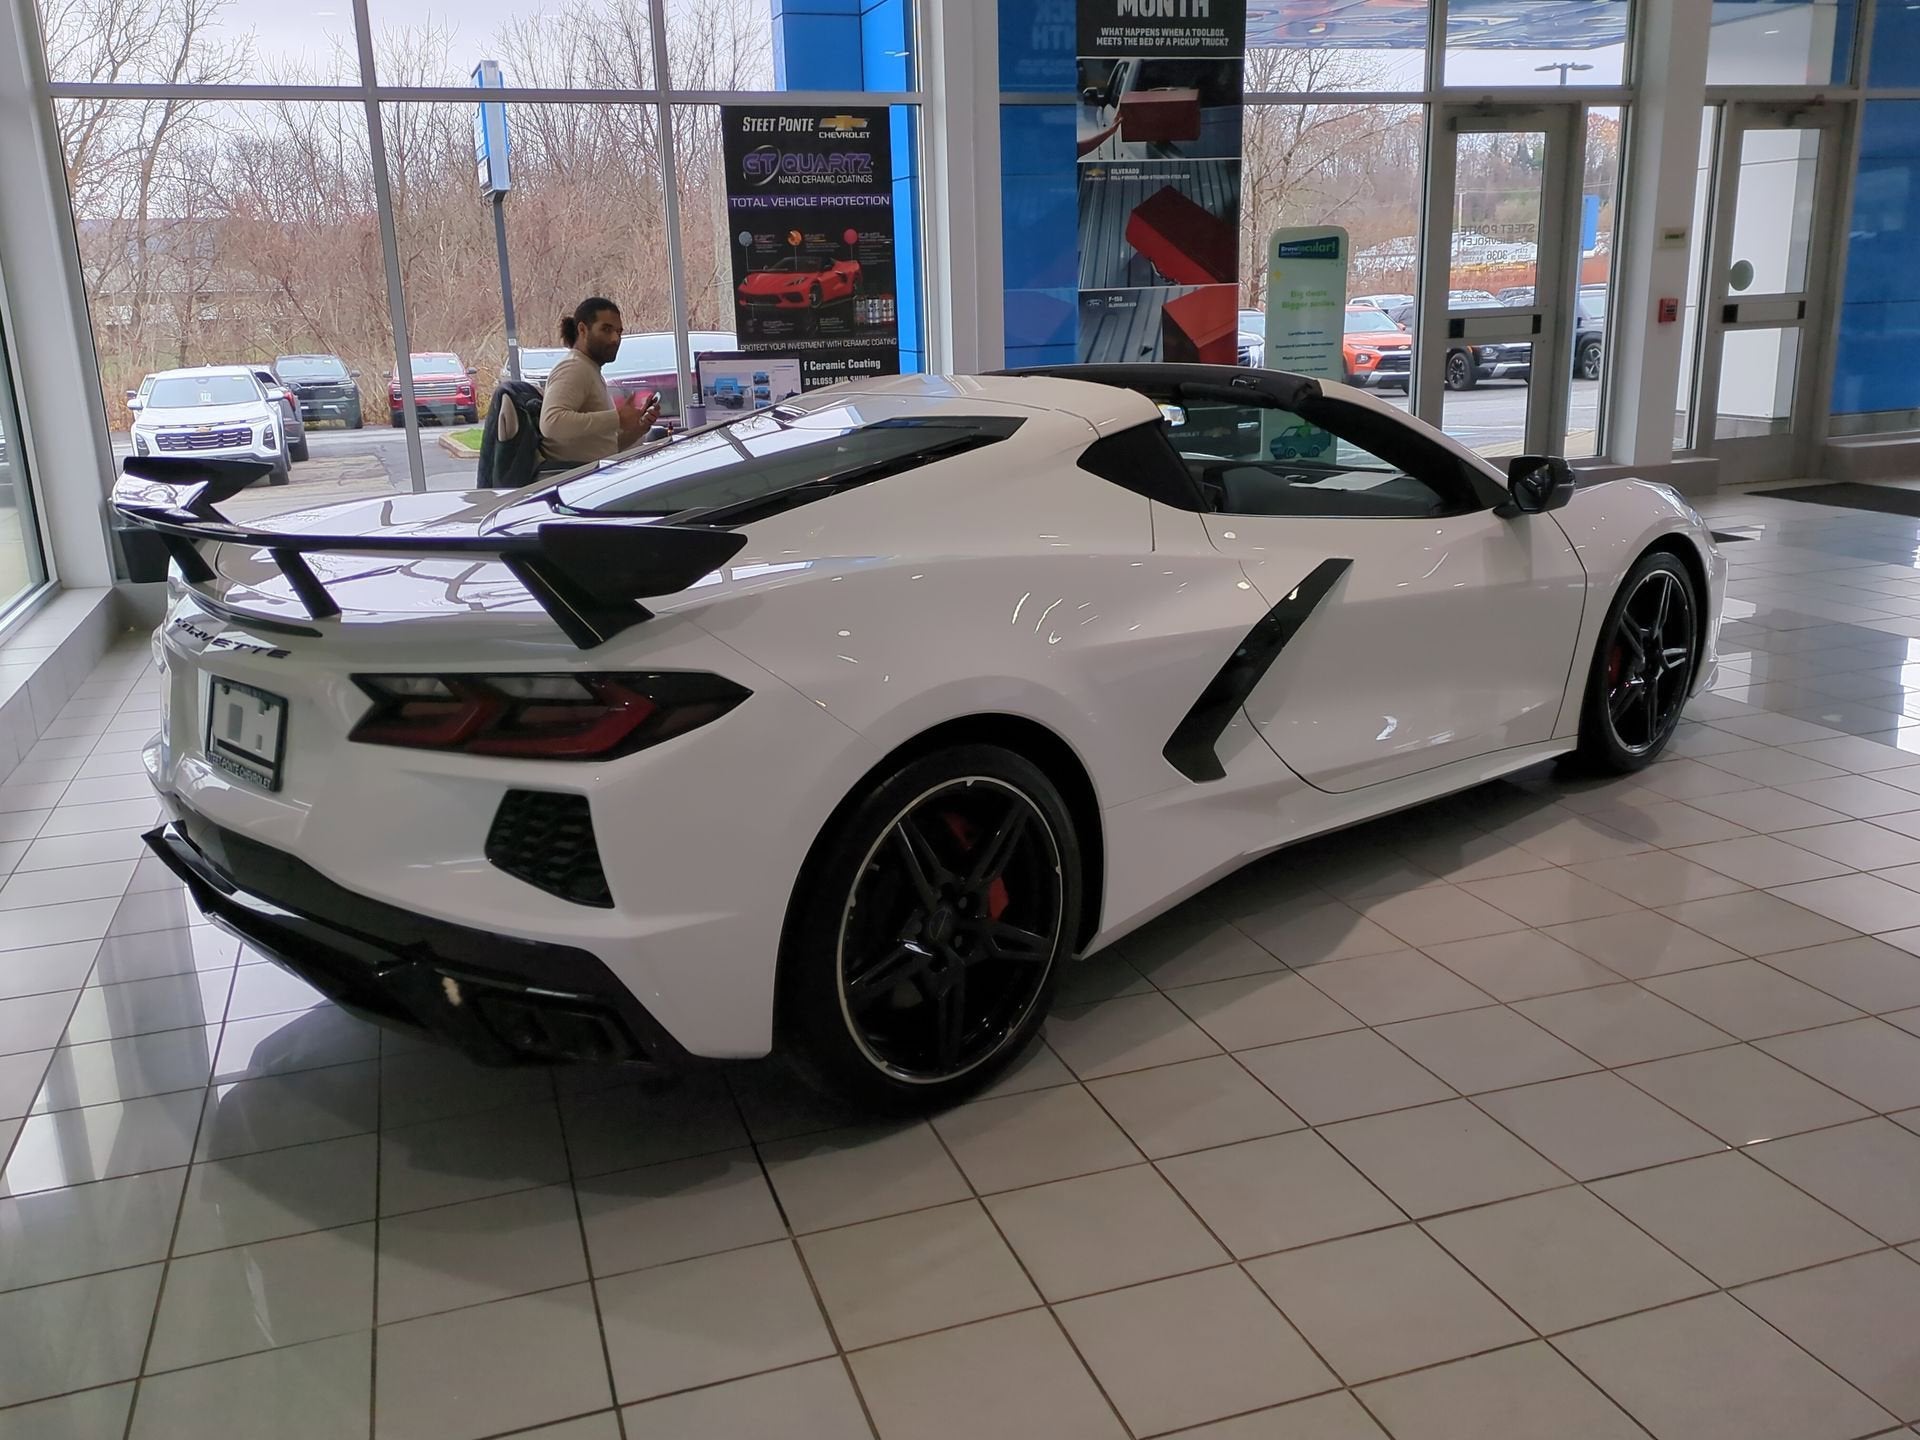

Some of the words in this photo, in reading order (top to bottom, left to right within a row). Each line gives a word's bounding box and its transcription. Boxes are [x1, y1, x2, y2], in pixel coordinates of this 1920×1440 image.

[1101, 27, 1123, 37] WHAT
[1125, 27, 1160, 37] HAPPENS
[1161, 28, 1184, 37] WHEN
[1185, 28, 1191, 37] A
[1192, 28, 1225, 37] TOOLBOX
[1096, 37, 1122, 46] MEETS
[1123, 37, 1138, 46] THE
[1140, 37, 1154, 46] BED
[1155, 37, 1165, 46] OF
[1166, 37, 1172, 46] A
[1172, 37, 1200, 46] PICKUP
[1201, 37, 1230, 46] TRUCK?
[742, 116, 776, 132] STEET
[778, 117, 815, 132] PONTE
[818, 131, 871, 139] CHEVROLET
[743, 153, 777, 175] GT
[781, 153, 873, 174] QUARTZ
[778, 175, 801, 184] NANO
[802, 175, 836, 184] CERAMIC
[837, 174, 873, 184] COATINGS
[731, 198, 768, 207] TOTAL
[771, 197, 817, 207] VEHICLE
[820, 196, 890, 207] PROTECTION
[769, 342, 786, 350] YOUR
[787, 341, 825, 350] INVESTMENT
[826, 340, 842, 348] WITH
[843, 339, 871, 348] CERAMIC
[871, 337, 897, 346] COATING
[810, 360, 846, 371] Ceramic
[848, 358, 881, 370] Coating
[812, 376, 833, 386] GLOSS
[834, 375, 849, 385] AND
[174, 617, 292, 660] CORVETTE
